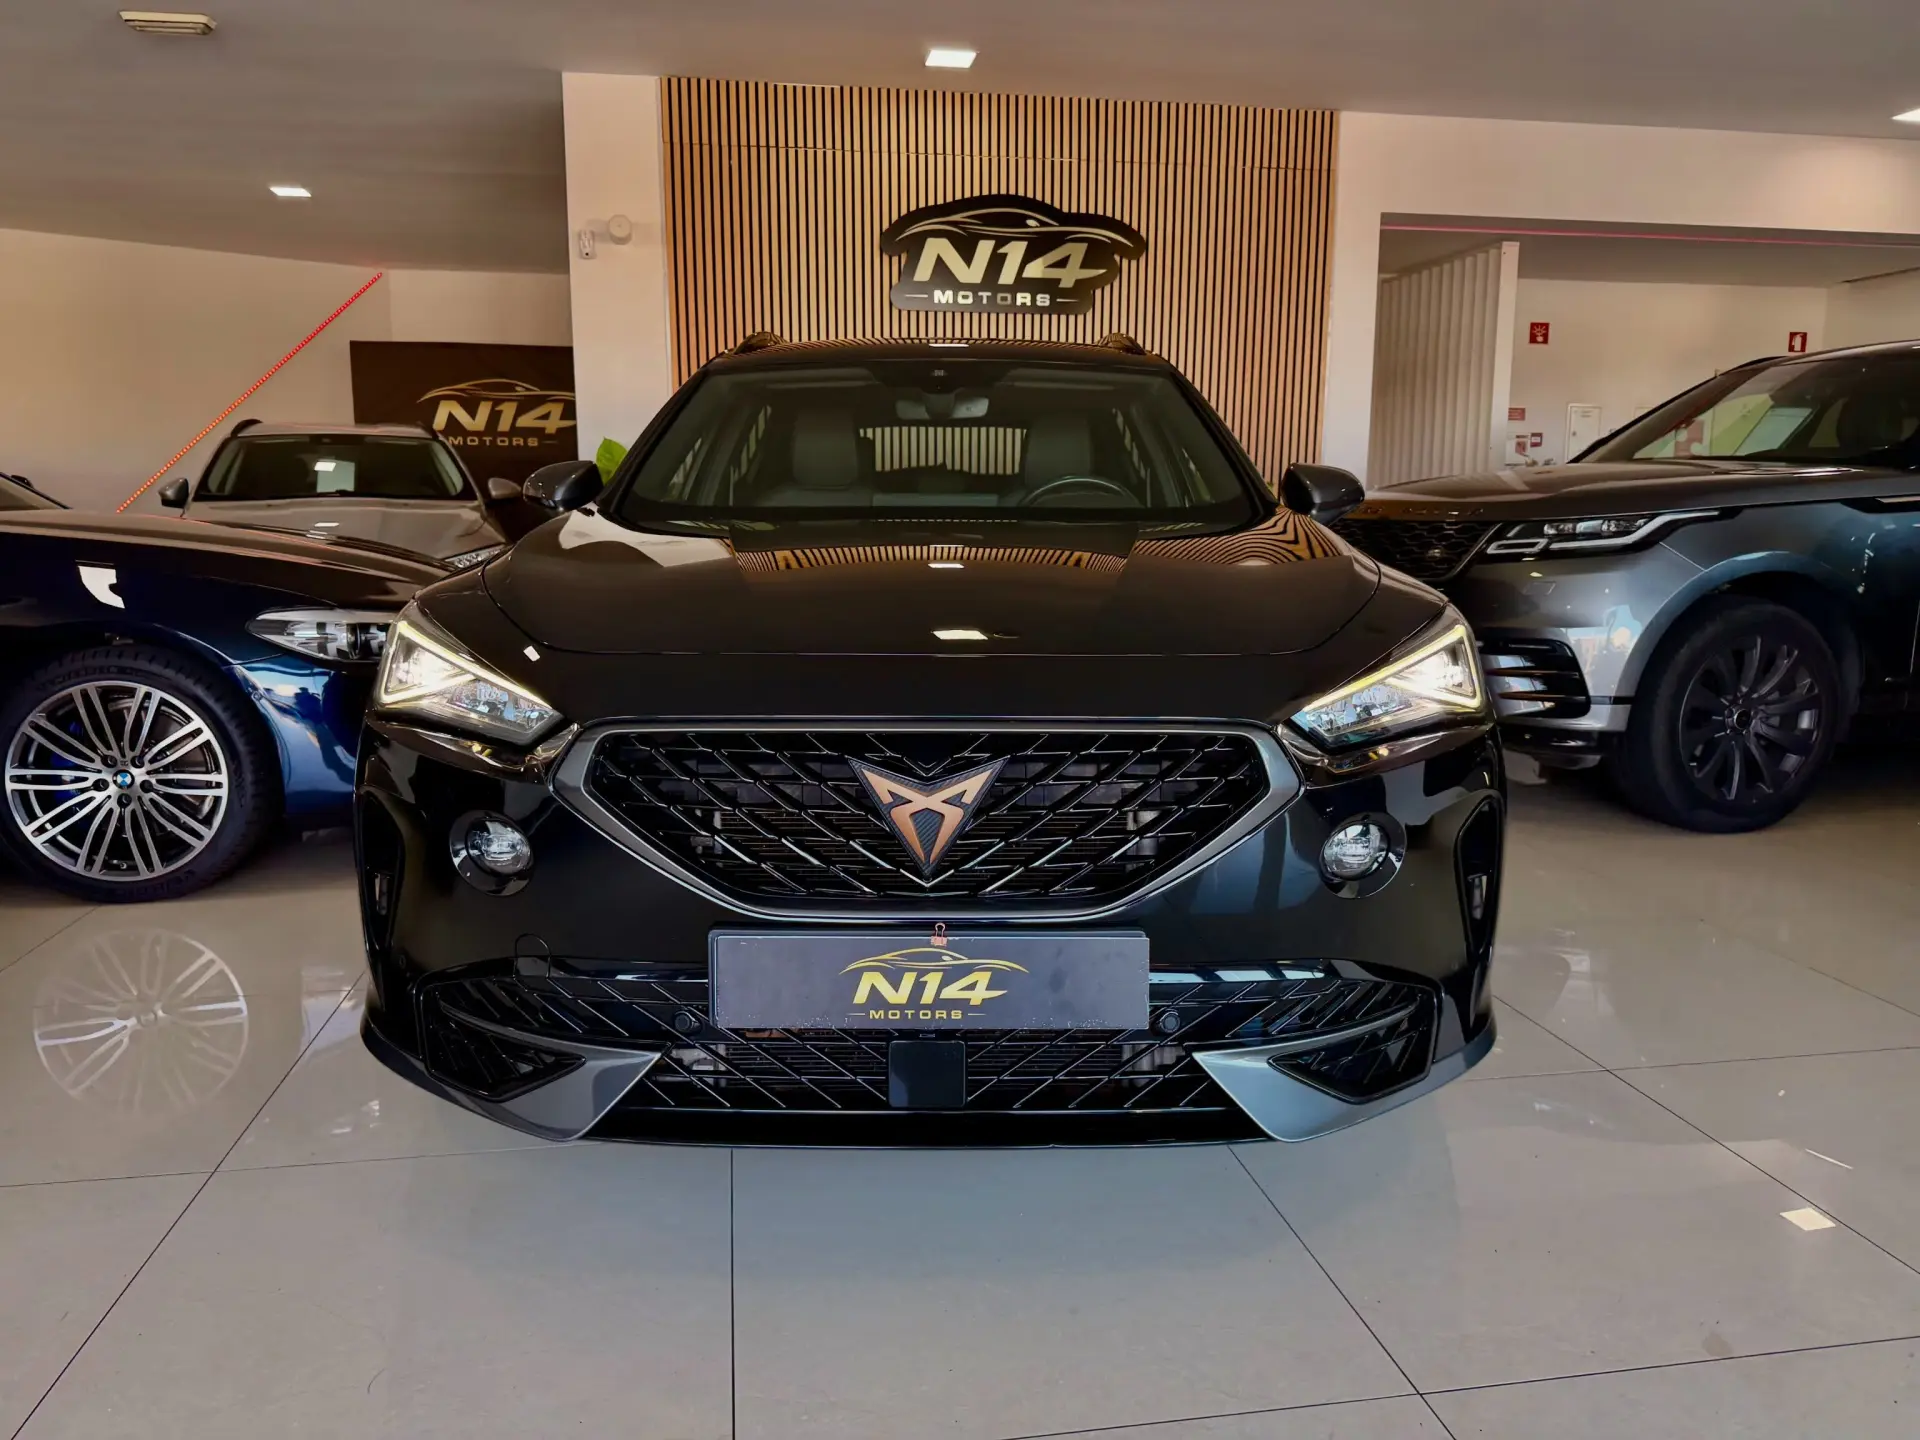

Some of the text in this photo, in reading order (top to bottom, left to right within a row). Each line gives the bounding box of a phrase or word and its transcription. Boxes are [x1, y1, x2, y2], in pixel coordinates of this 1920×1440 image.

[912, 237, 1108, 288] N14
[933, 289, 1051, 307] MOTORS
[432, 399, 577, 434] N14
[448, 436, 539, 447] MOTORS
[852, 971, 1008, 1006] N14
[869, 1009, 963, 1020] MOTORS
